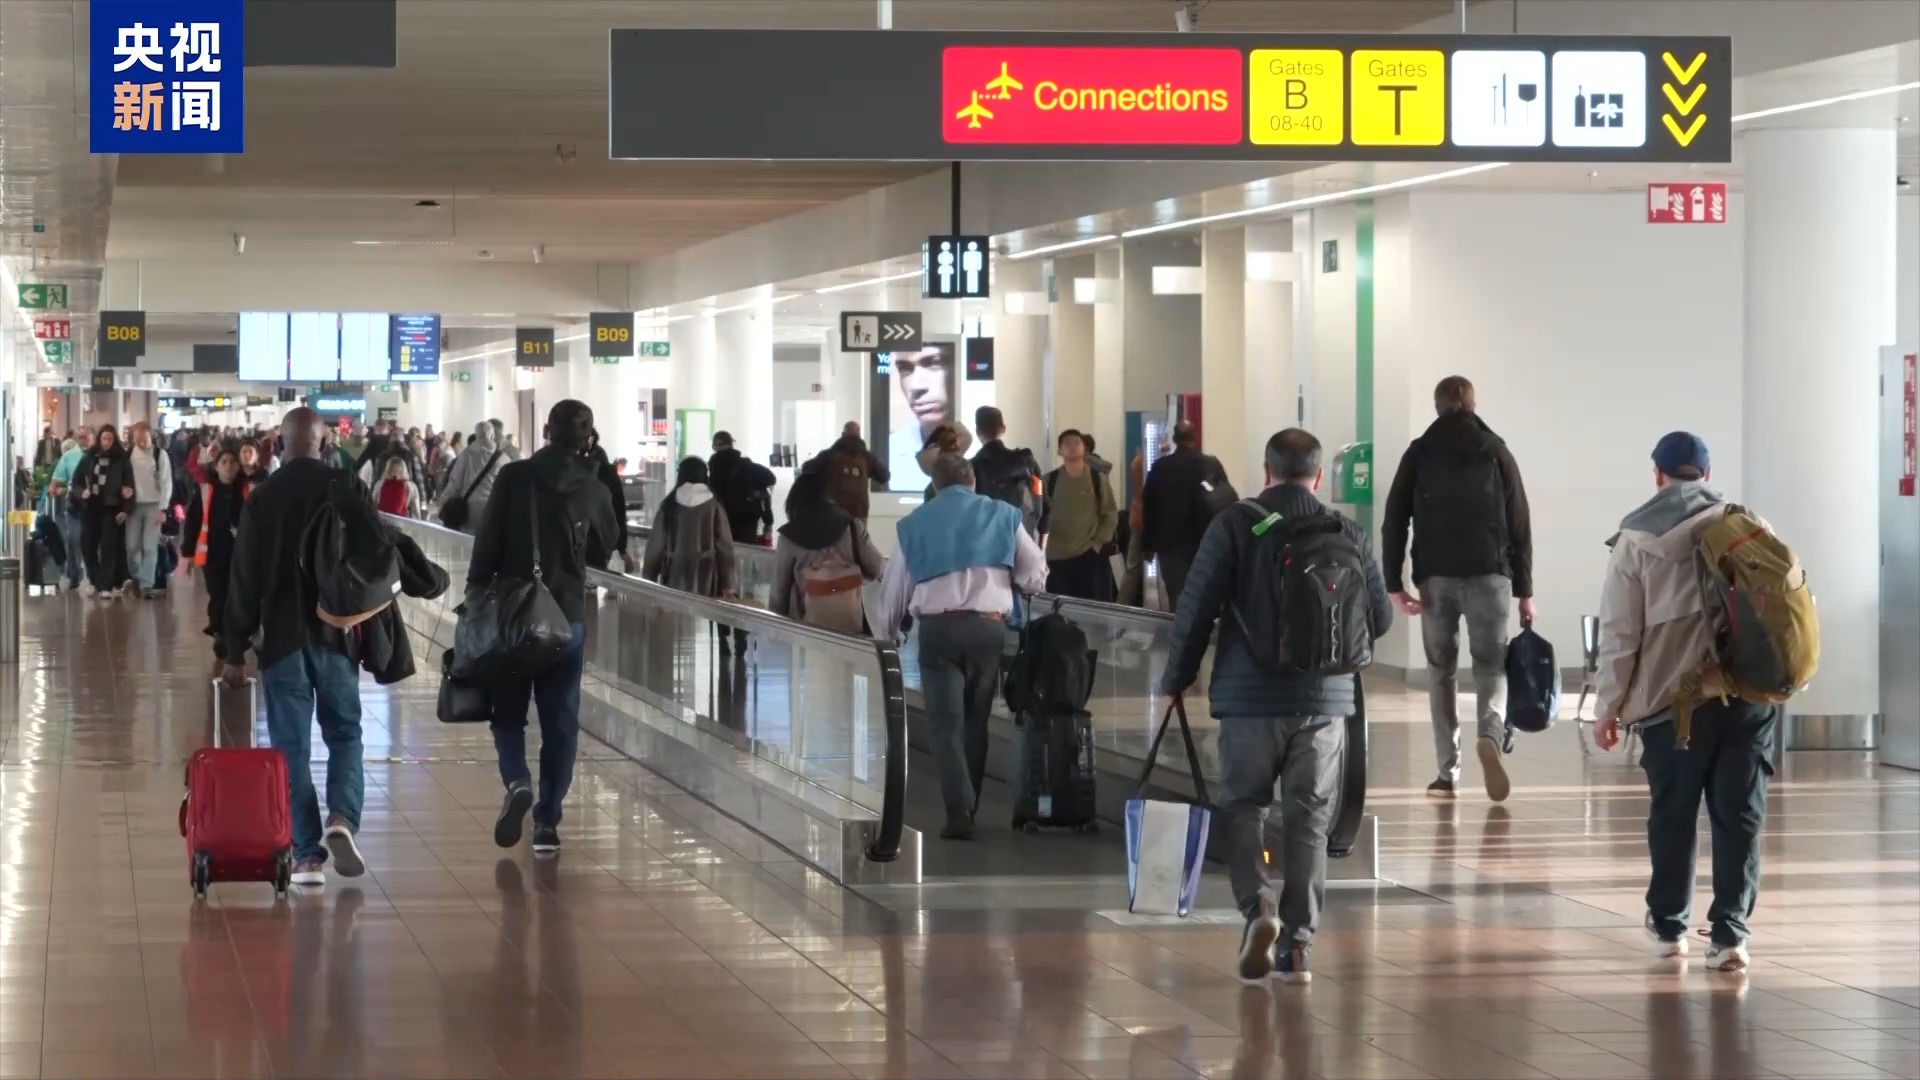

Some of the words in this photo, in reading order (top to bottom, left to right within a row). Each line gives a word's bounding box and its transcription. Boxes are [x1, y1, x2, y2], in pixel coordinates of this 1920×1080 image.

[1268, 58, 1325, 77] Gates
[1368, 59, 1428, 78] Gates
[1033, 81, 1229, 111] Connections
[1285, 80, 1308, 109] B
[1377, 85, 1418, 136] T
[1269, 114, 1323, 132] 08-40
[107, 325, 140, 341] B08
[596, 326, 629, 342] B09
[523, 341, 550, 354] B11
